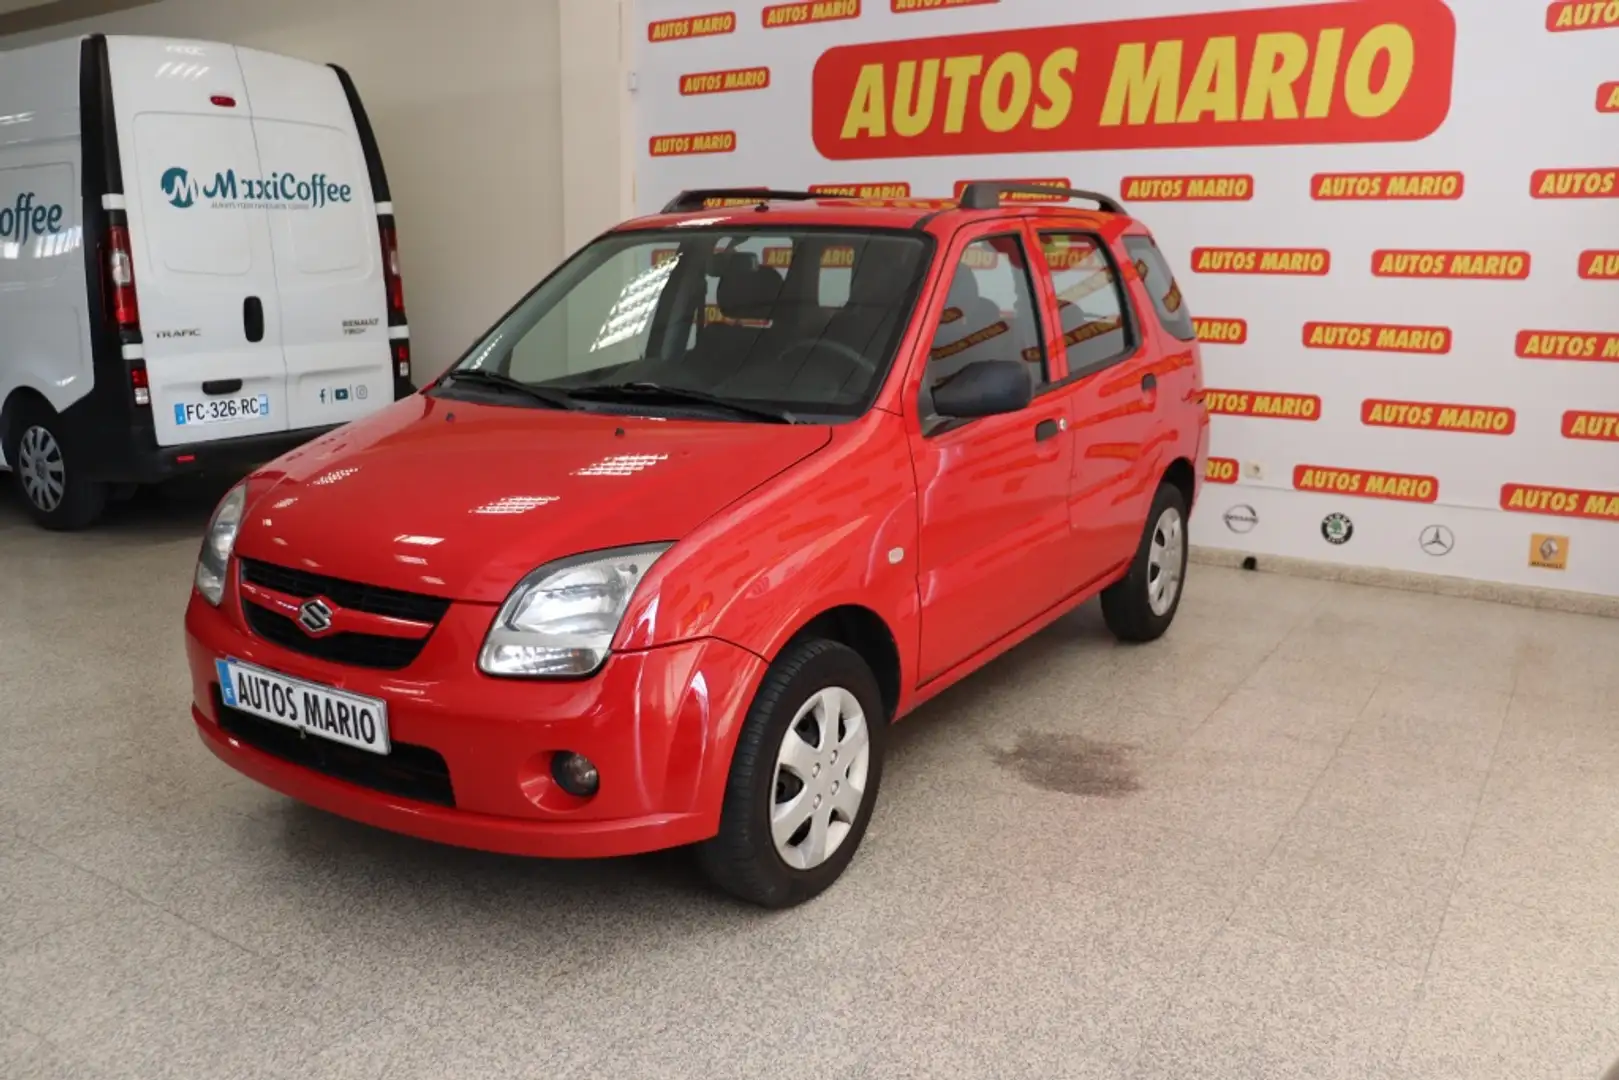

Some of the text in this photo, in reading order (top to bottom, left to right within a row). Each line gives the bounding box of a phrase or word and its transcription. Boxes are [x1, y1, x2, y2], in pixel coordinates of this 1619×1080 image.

[767, 0, 858, 24] AUTOS MARIO
[653, 15, 732, 40] AUTOS MARIO
[684, 70, 767, 92] AUTOS MARIO
[840, 22, 1415, 140] AUTOS MARIO
[653, 134, 733, 153] AUTOS MARIO
[203, 169, 351, 208] MaxiCoffee
[1127, 178, 1249, 198] AUTOS MARIO
[1318, 175, 1458, 196] AUTOS MARIO
[1539, 173, 1616, 195] AUTOS
[1199, 251, 1325, 271] AUTOS MARIO
[1380, 254, 1524, 276] AUTOS MARIO
[1310, 325, 1446, 350] AUTOS MARIO
[1524, 335, 1597, 357] AUTOS
[1205, 392, 1315, 417] UTOS MARIO
[1370, 404, 1509, 430] AUTOS MARIO
[1300, 470, 1433, 498] AUTOS MARIO
[1508, 487, 1579, 512] AUTOS
[237, 671, 376, 745] AUTOS MARIO
